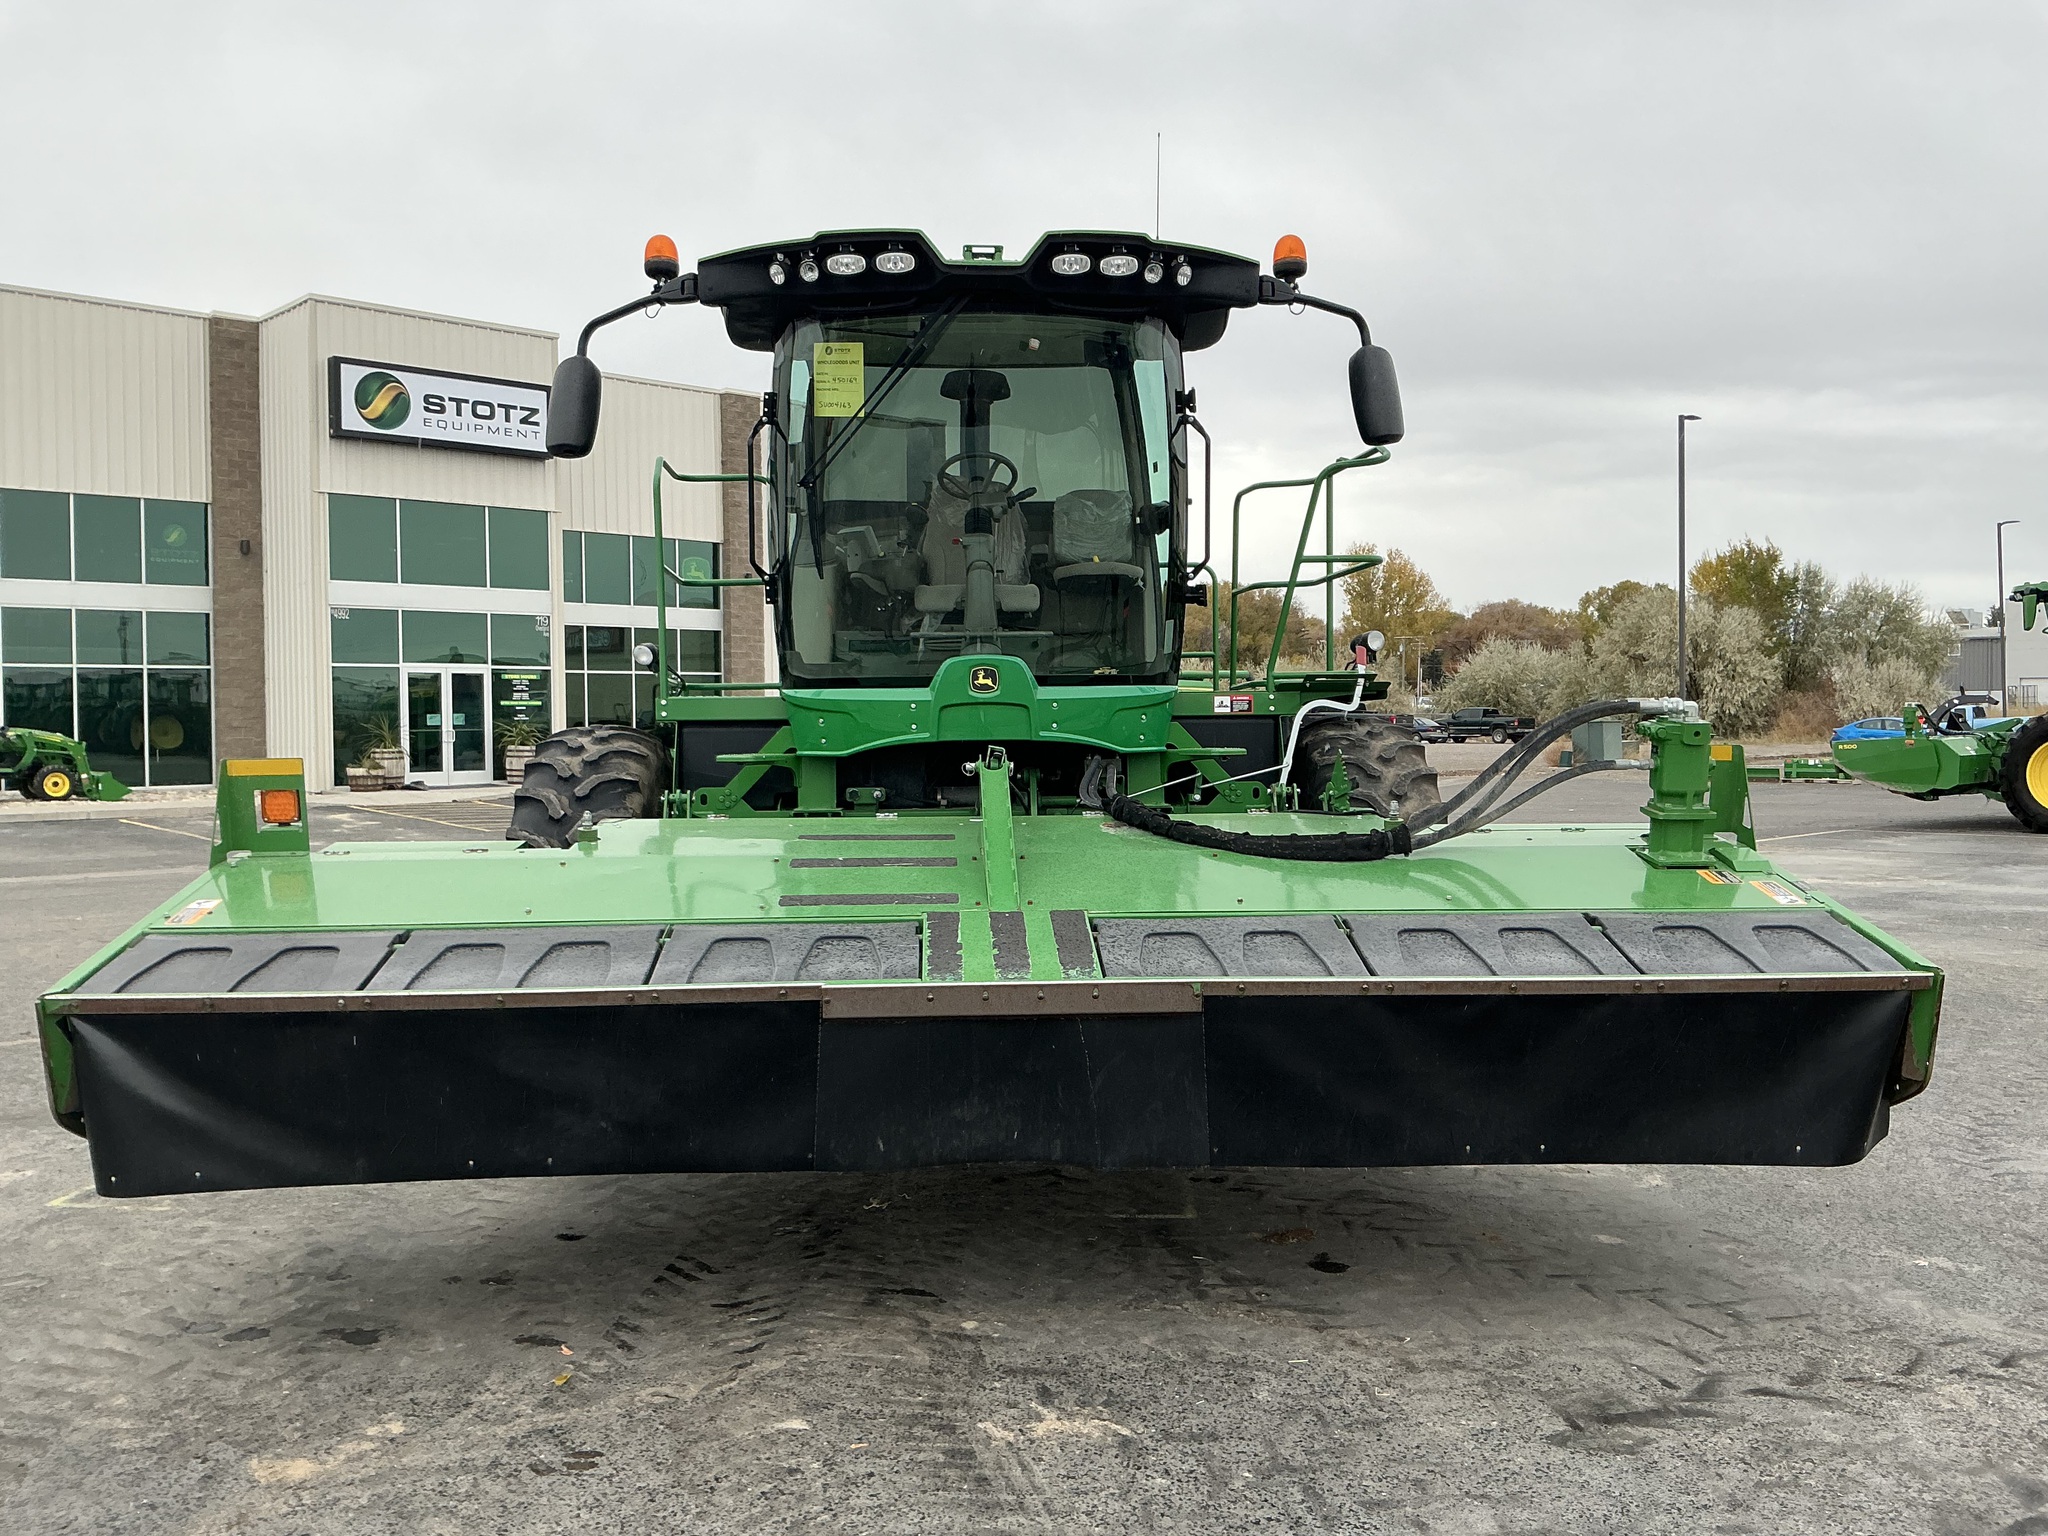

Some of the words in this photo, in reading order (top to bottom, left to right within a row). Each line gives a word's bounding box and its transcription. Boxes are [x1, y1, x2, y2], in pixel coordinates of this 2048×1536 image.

[423, 394, 540, 427] STOTZ
[423, 418, 540, 440] EQUIPMENT
[535, 616, 549, 626] 119
